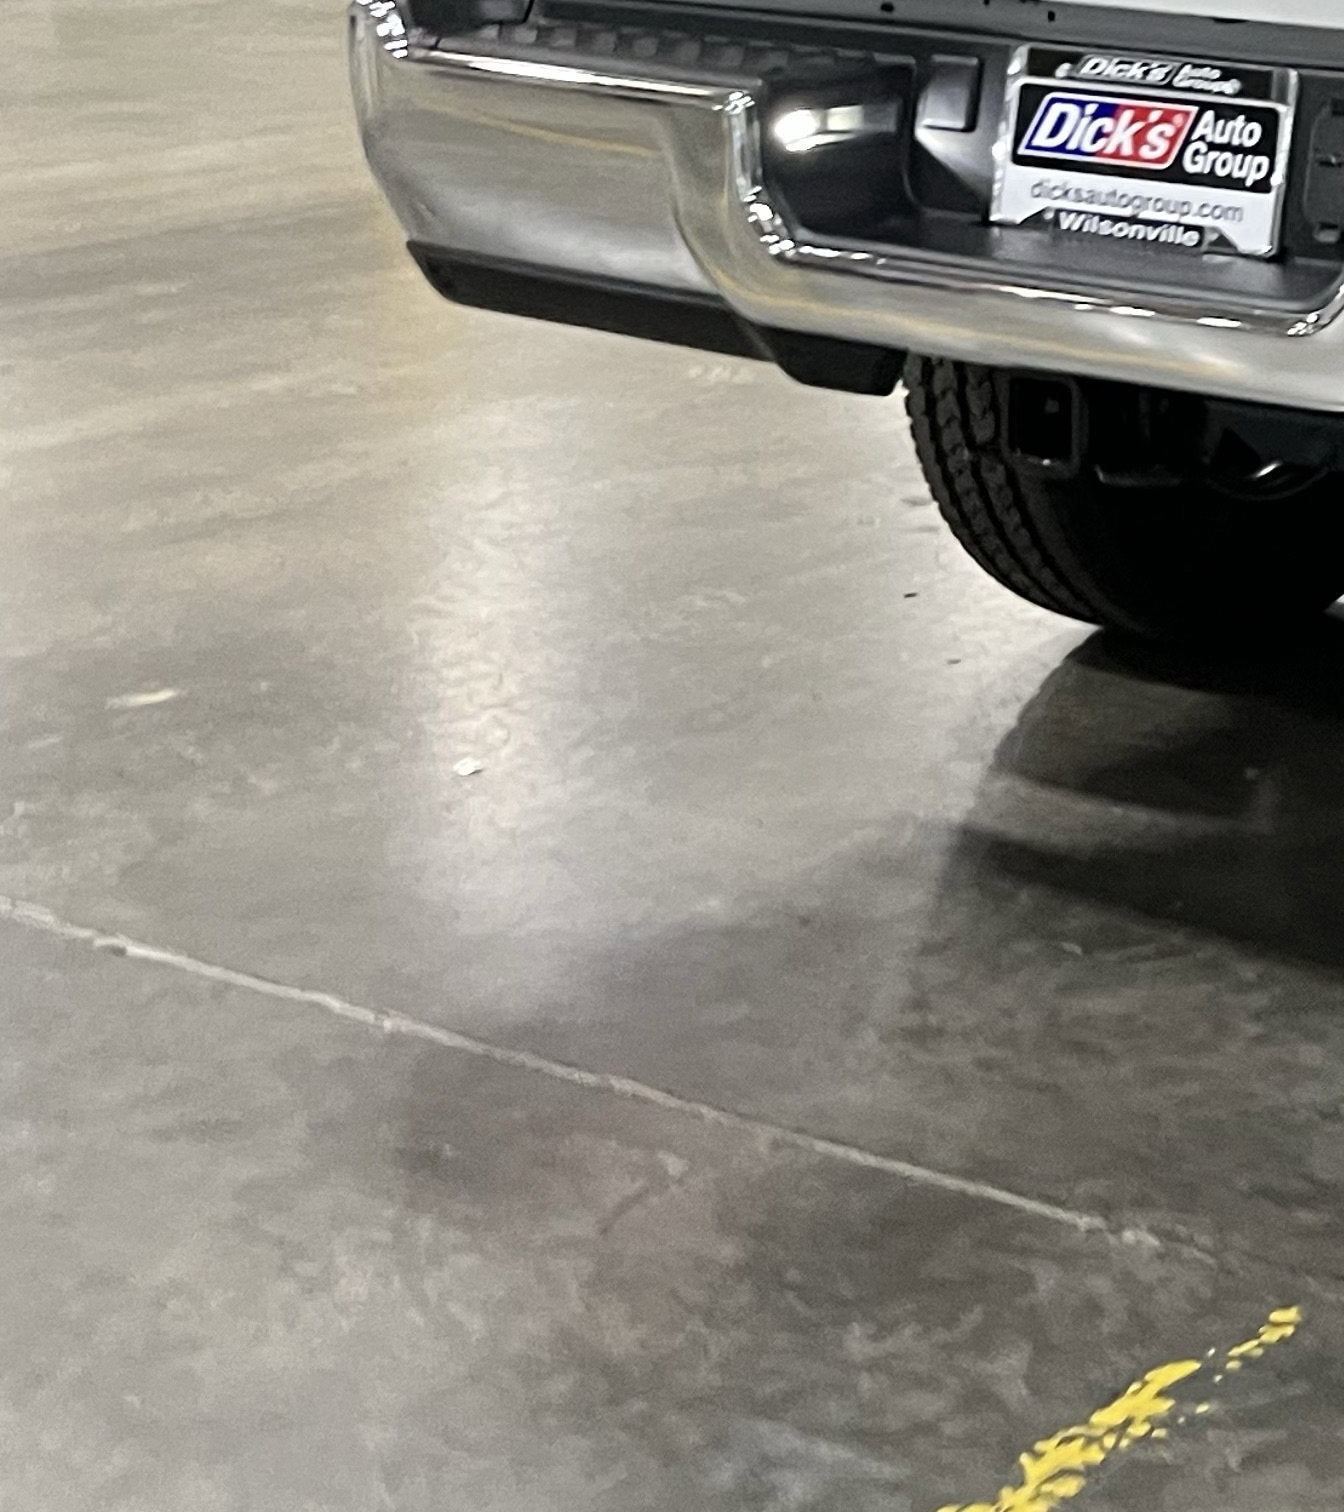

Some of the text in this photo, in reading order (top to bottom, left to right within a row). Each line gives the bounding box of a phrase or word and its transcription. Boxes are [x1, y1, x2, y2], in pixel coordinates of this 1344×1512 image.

[1031, 101, 1176, 160] Dick's
[1191, 109, 1263, 148] Auto
[1181, 141, 1271, 188] Group
[1030, 179, 1245, 224] dicksautogroup.com
[1058, 210, 1201, 248] Wilsonville
